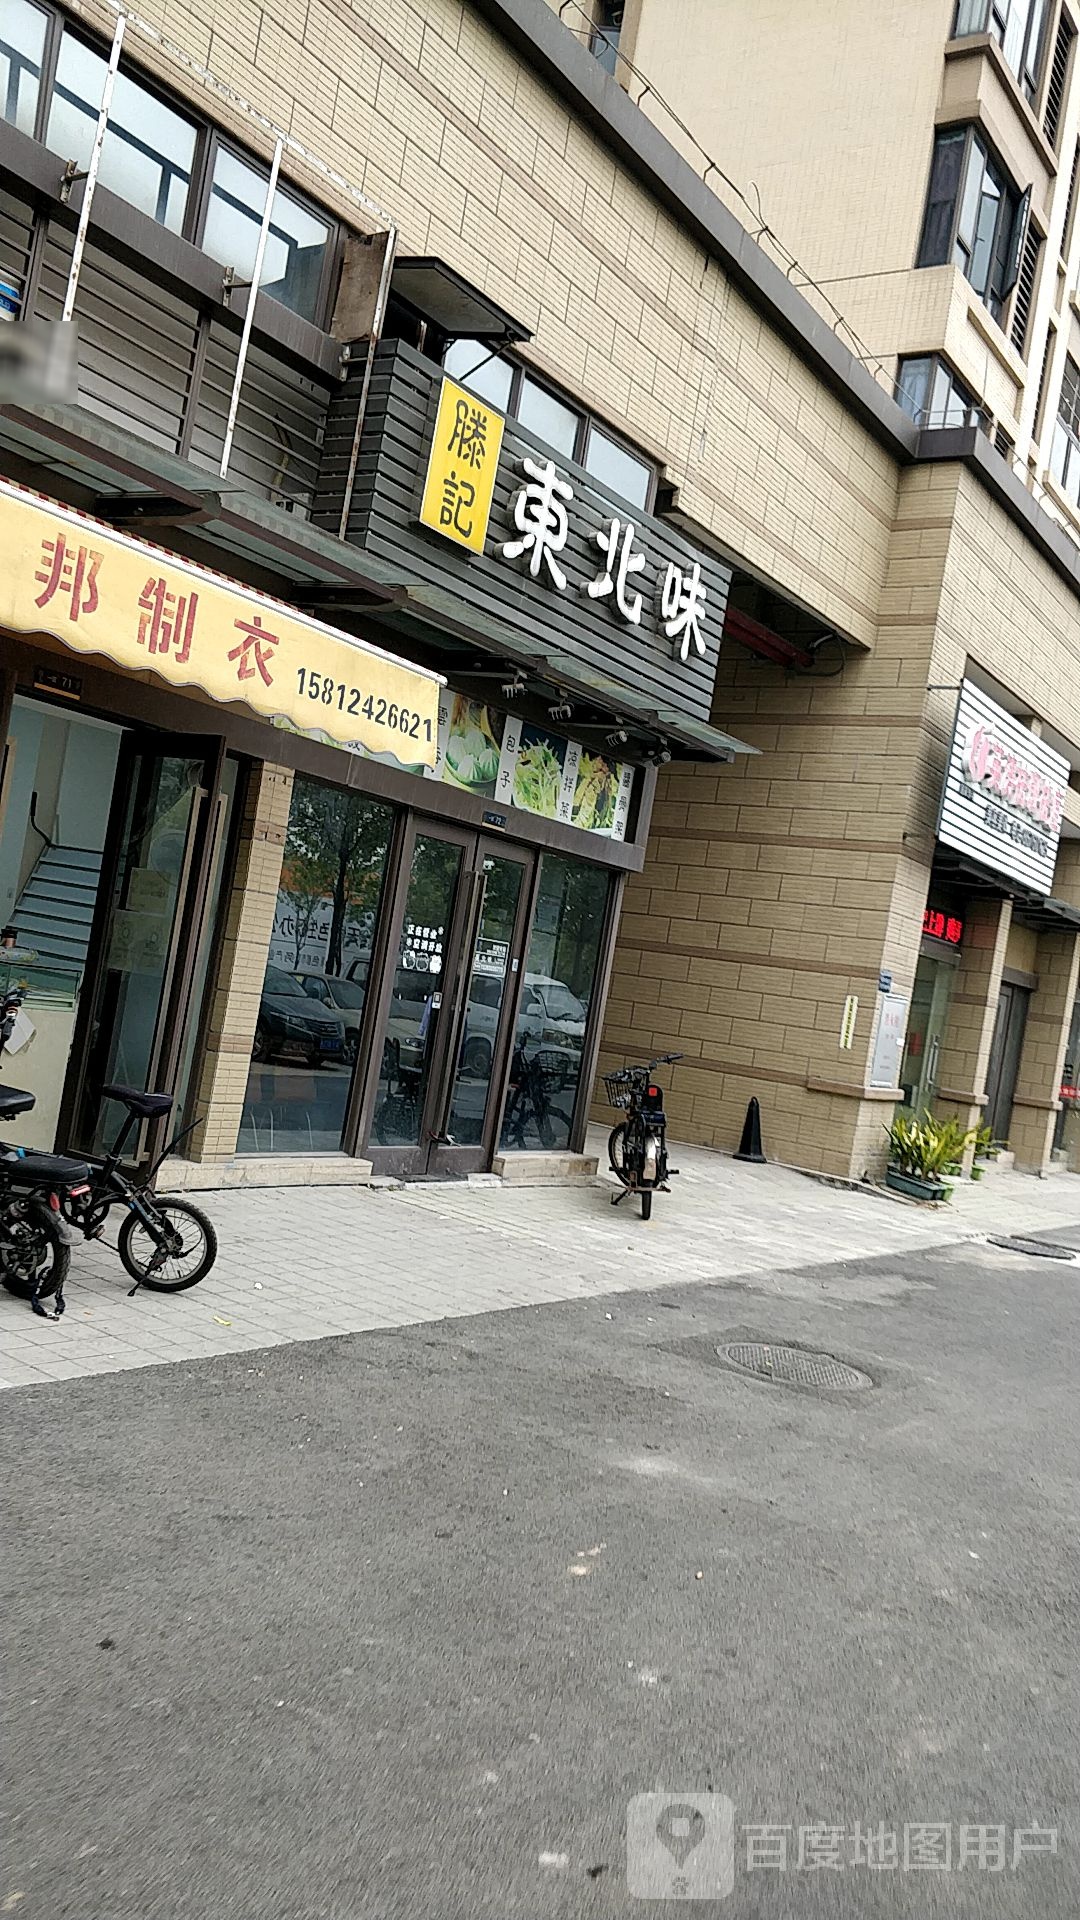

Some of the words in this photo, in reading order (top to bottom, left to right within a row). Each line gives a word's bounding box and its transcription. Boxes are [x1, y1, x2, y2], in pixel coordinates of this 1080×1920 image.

[34, 532, 280, 687] 邦制衣
[502, 457, 708, 661] 東北味
[296, 667, 434, 744] 15812426621
[500, 735, 516, 788] 包子
